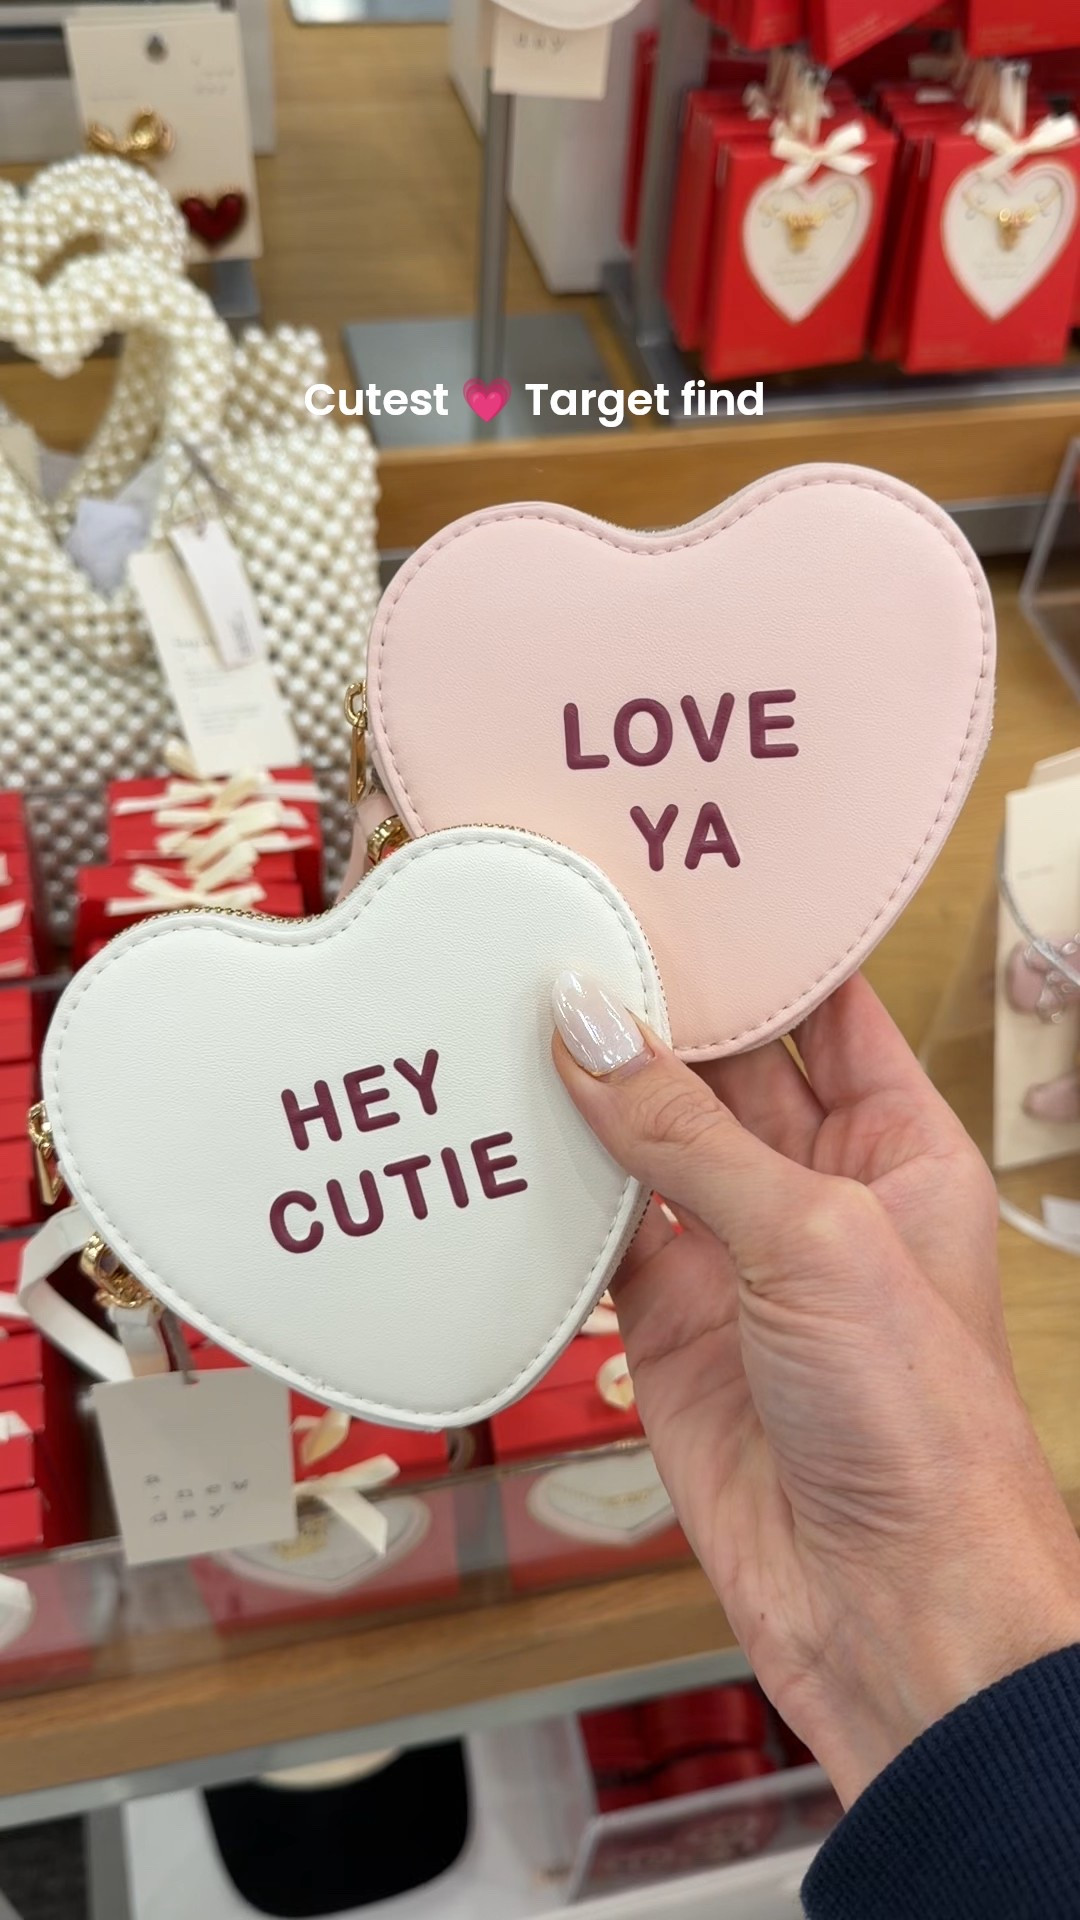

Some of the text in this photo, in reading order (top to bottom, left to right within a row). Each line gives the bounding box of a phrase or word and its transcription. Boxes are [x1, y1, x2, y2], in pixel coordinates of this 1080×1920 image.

[562, 689, 799, 771] LOVE
[629, 801, 742, 872] YA
[280, 1048, 440, 1151] HEY
[269, 1131, 529, 1254] CUTIE
